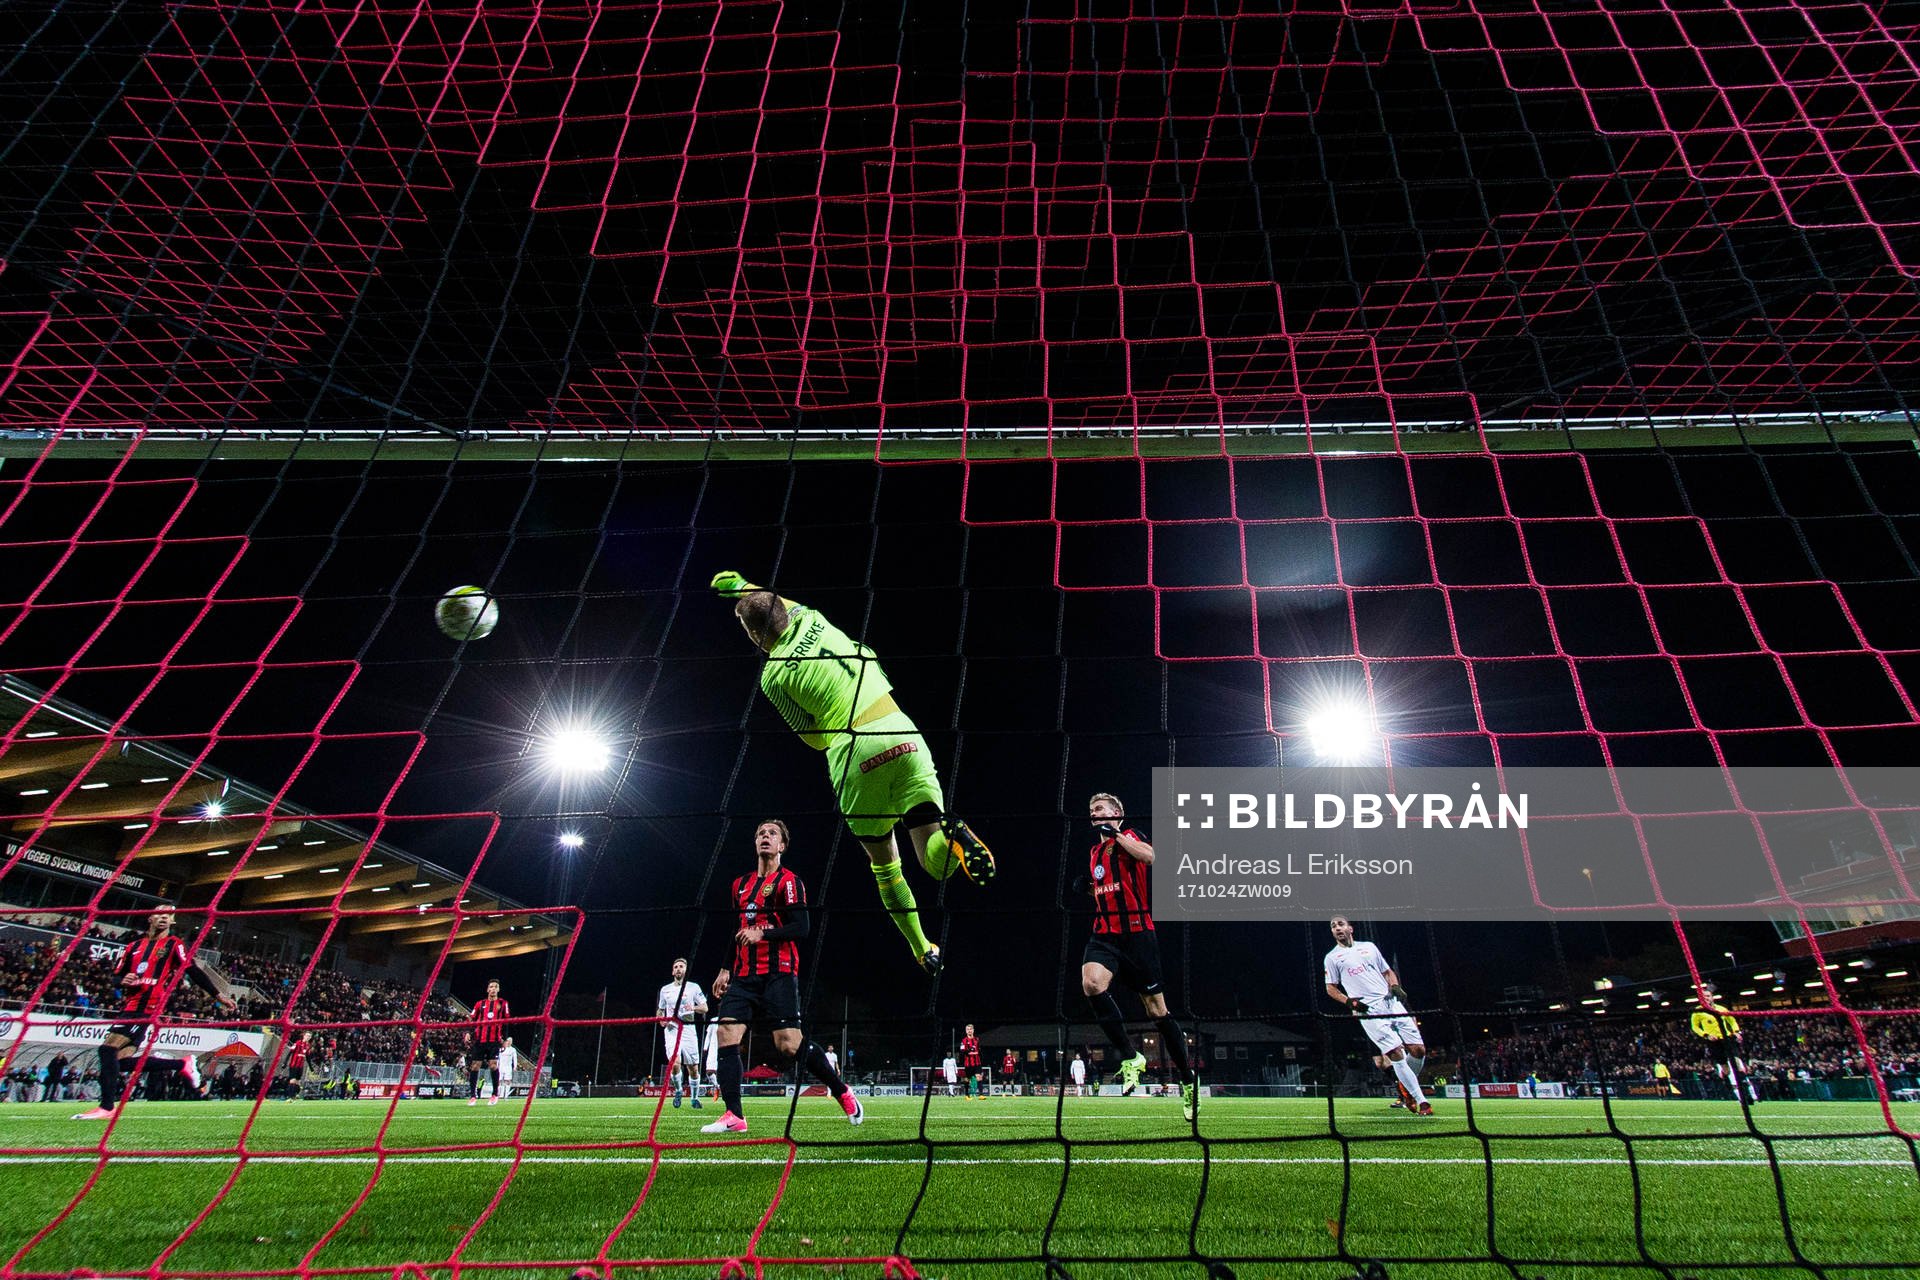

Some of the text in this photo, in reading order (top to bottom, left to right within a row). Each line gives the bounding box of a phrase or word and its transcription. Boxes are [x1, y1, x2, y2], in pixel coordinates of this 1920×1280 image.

[784, 621, 825, 671] SERNEKE
[860, 743, 918, 773] BAUHAUS
[6, 844, 18, 856] VI
[18, 846, 51, 866] YGGER
[50, 856, 83, 873] SVENSK
[55, 1020, 200, 1046] Volkswa tockholm
